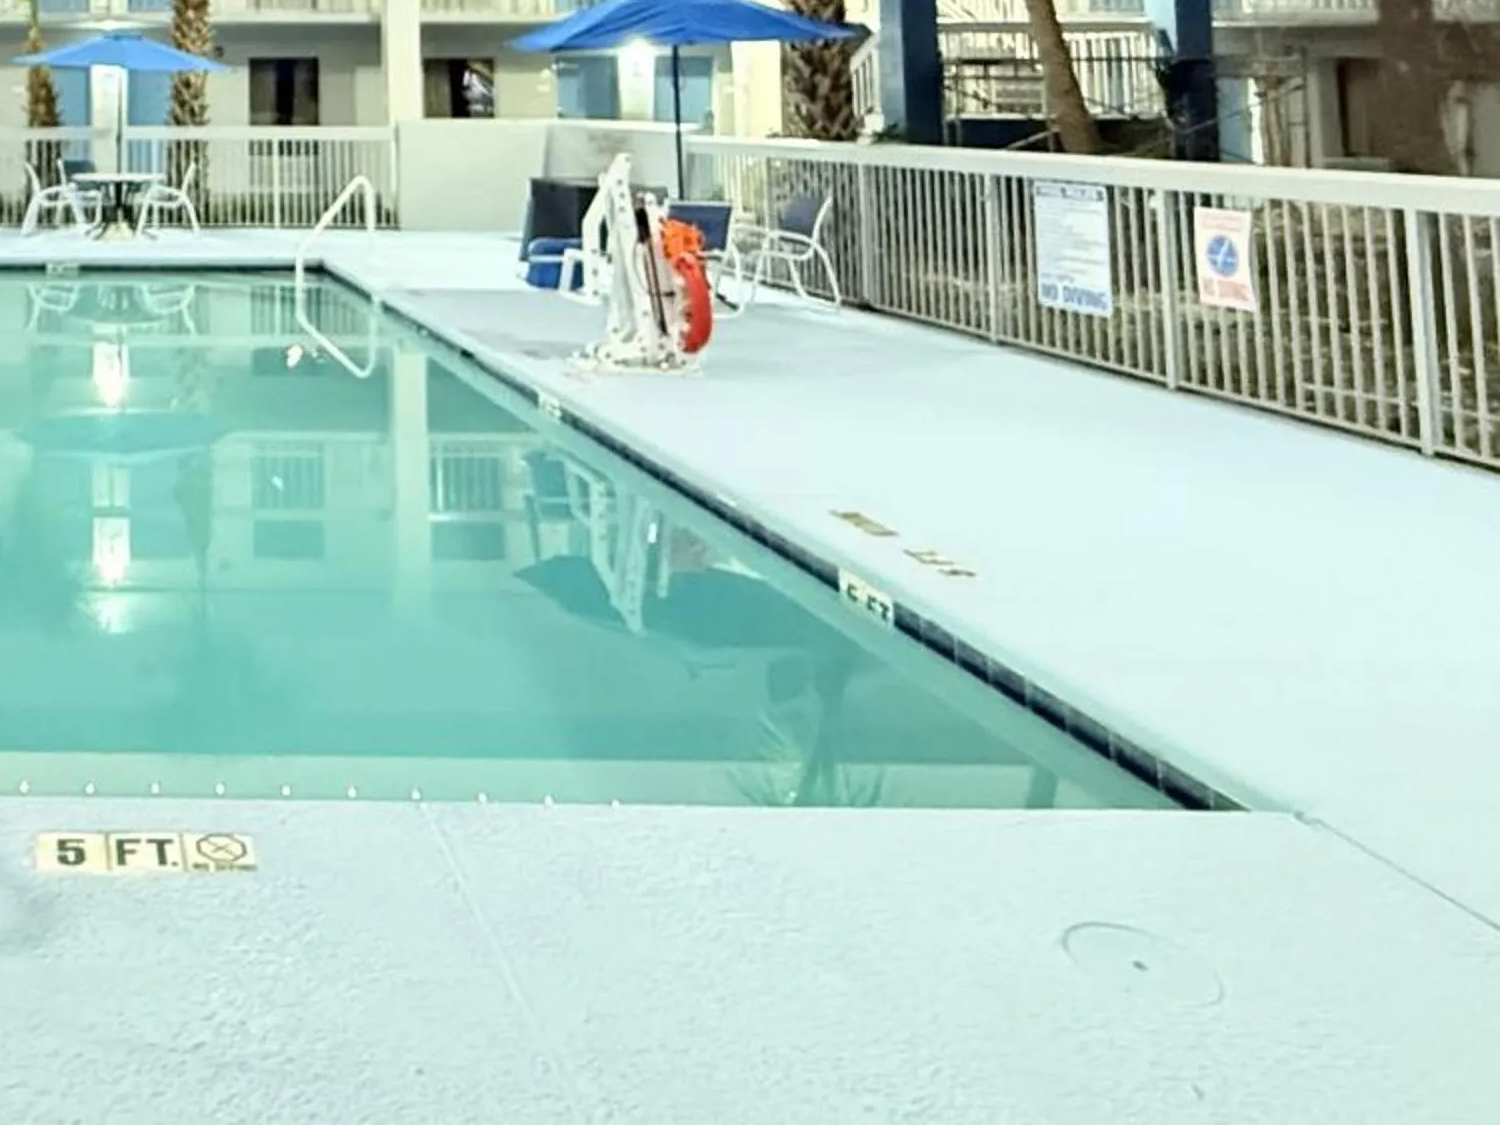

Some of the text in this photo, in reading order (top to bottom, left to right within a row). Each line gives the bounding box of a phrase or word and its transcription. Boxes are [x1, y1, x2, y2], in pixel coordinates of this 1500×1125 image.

[1041, 282, 1108, 311] NO DIVING
[56, 838, 86, 866] 5
